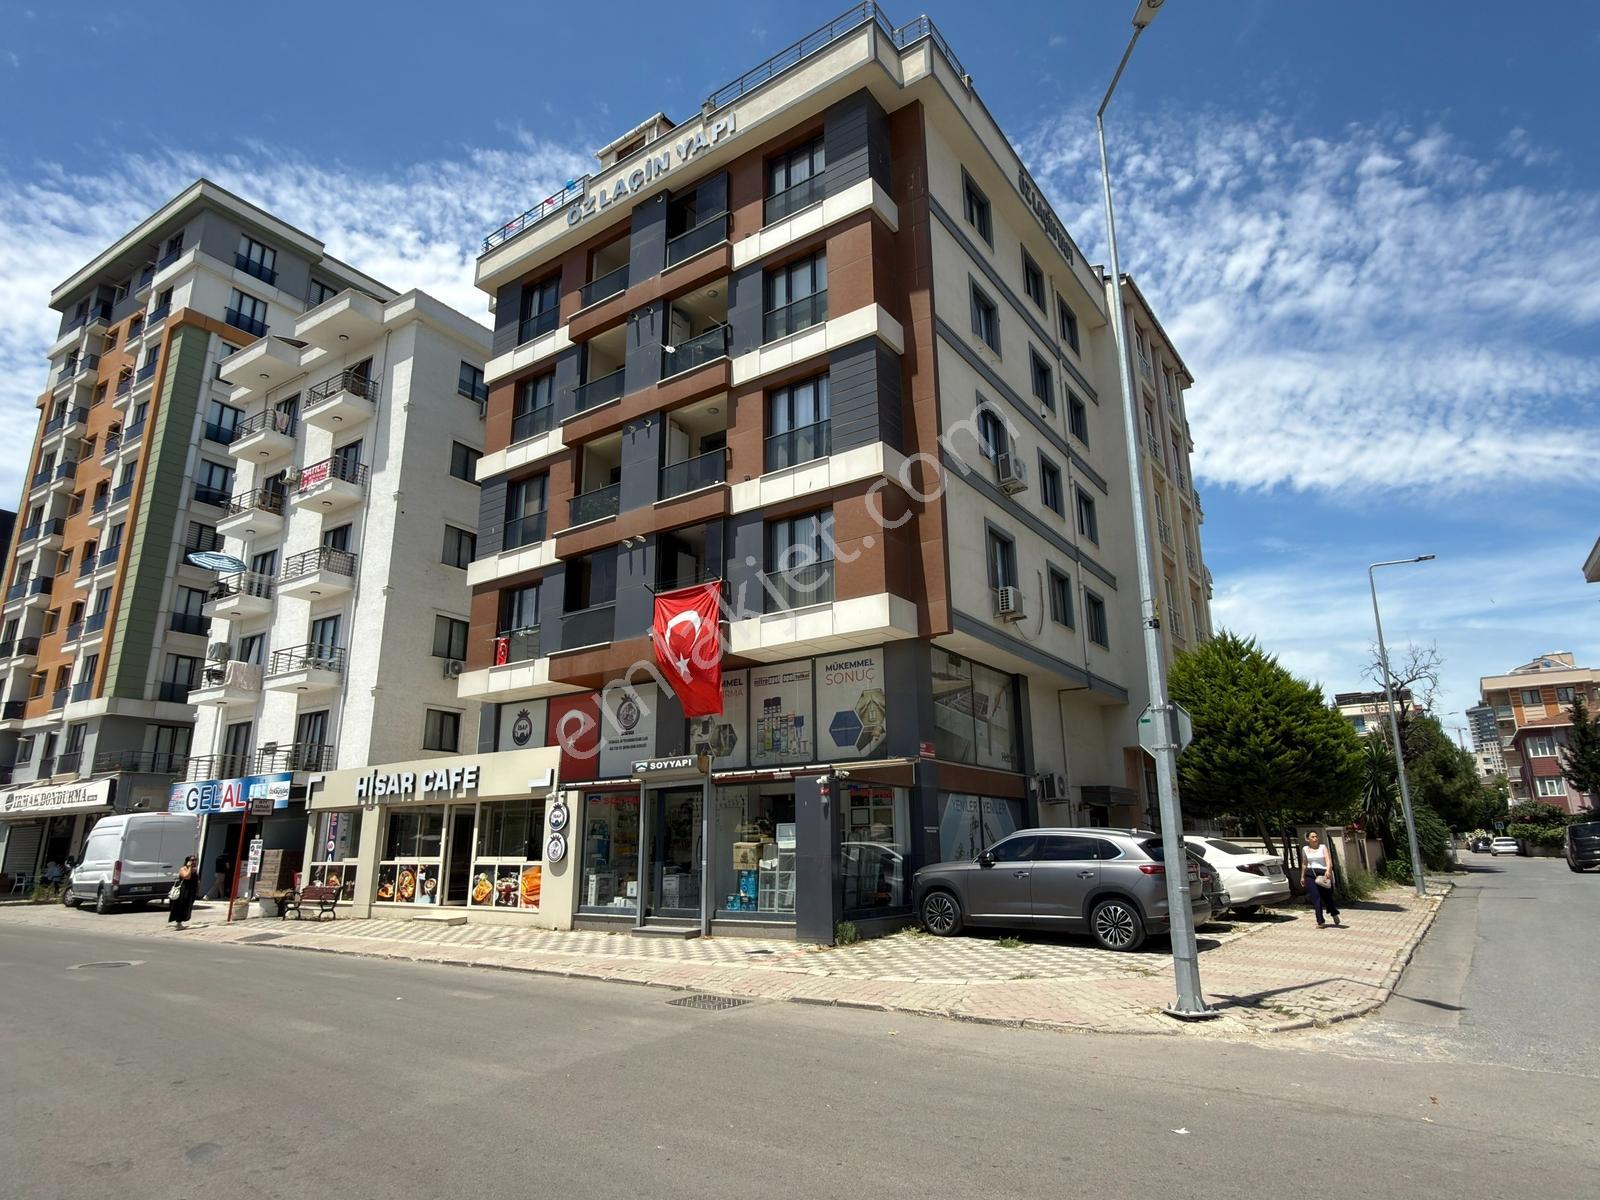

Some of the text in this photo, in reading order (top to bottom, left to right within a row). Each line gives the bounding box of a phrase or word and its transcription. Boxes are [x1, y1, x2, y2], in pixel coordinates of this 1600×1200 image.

[676, 112, 736, 163] YAPI
[825, 658, 875, 672] MÜKEMMEL
[825, 668, 875, 686] SONUÇ
[649, 758, 692, 770] SOYYAPI
[355, 765, 480, 797] HİSAR CAFE
